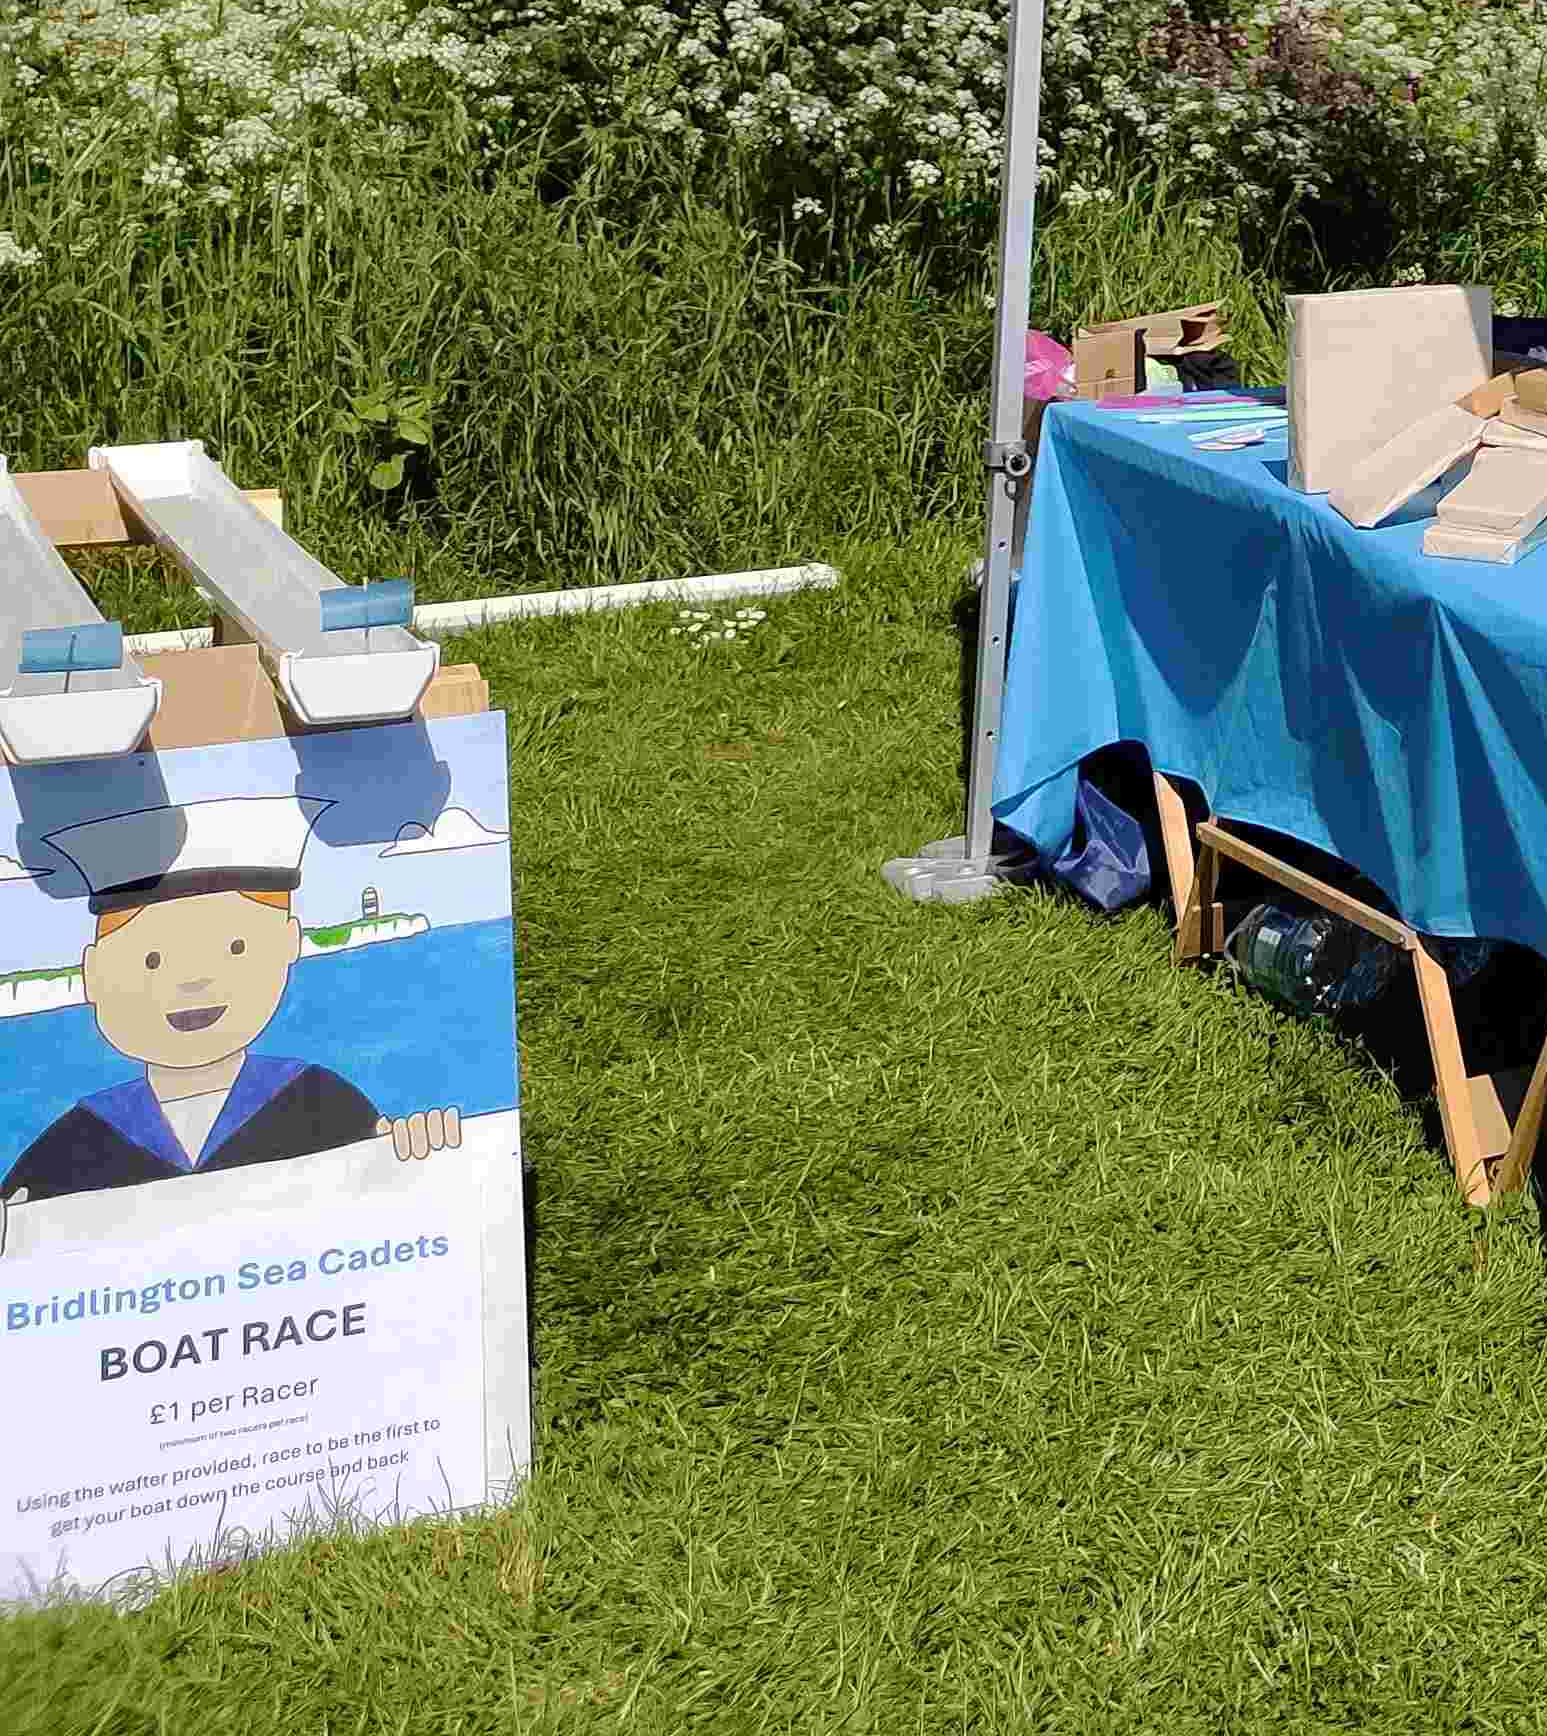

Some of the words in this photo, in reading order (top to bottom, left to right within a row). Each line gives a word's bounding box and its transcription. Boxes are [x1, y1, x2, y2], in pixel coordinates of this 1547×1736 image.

[6, 1272, 226, 1331] Bridlington
[237, 1259, 307, 1291] Sea
[318, 1233, 450, 1276] Cadets
[100, 1326, 229, 1382] BOAT
[242, 1302, 367, 1356] RACE
[150, 1401, 180, 1426] £1
[191, 1391, 234, 1422] per
[242, 1376, 320, 1409] Racer
[17, 1488, 71, 1513] Using
[74, 1483, 105, 1505] the
[109, 1472, 169, 1496] wafter
[173, 1453, 257, 1486] provided,
[262, 1446, 302, 1466] race
[305, 1440, 323, 1454] to
[327, 1436, 349, 1451] be
[354, 1430, 382, 1446] the
[386, 1420, 421, 1441] first
[424, 1417, 441, 1432] to
[83, 1508, 128, 1531] your
[130, 1496, 172, 1518] boat
[176, 1488, 226, 1511] down
[231, 1480, 261, 1498] the
[265, 1467, 326, 1488] course
[330, 1457, 363, 1477] and
[367, 1449, 409, 1469] back
